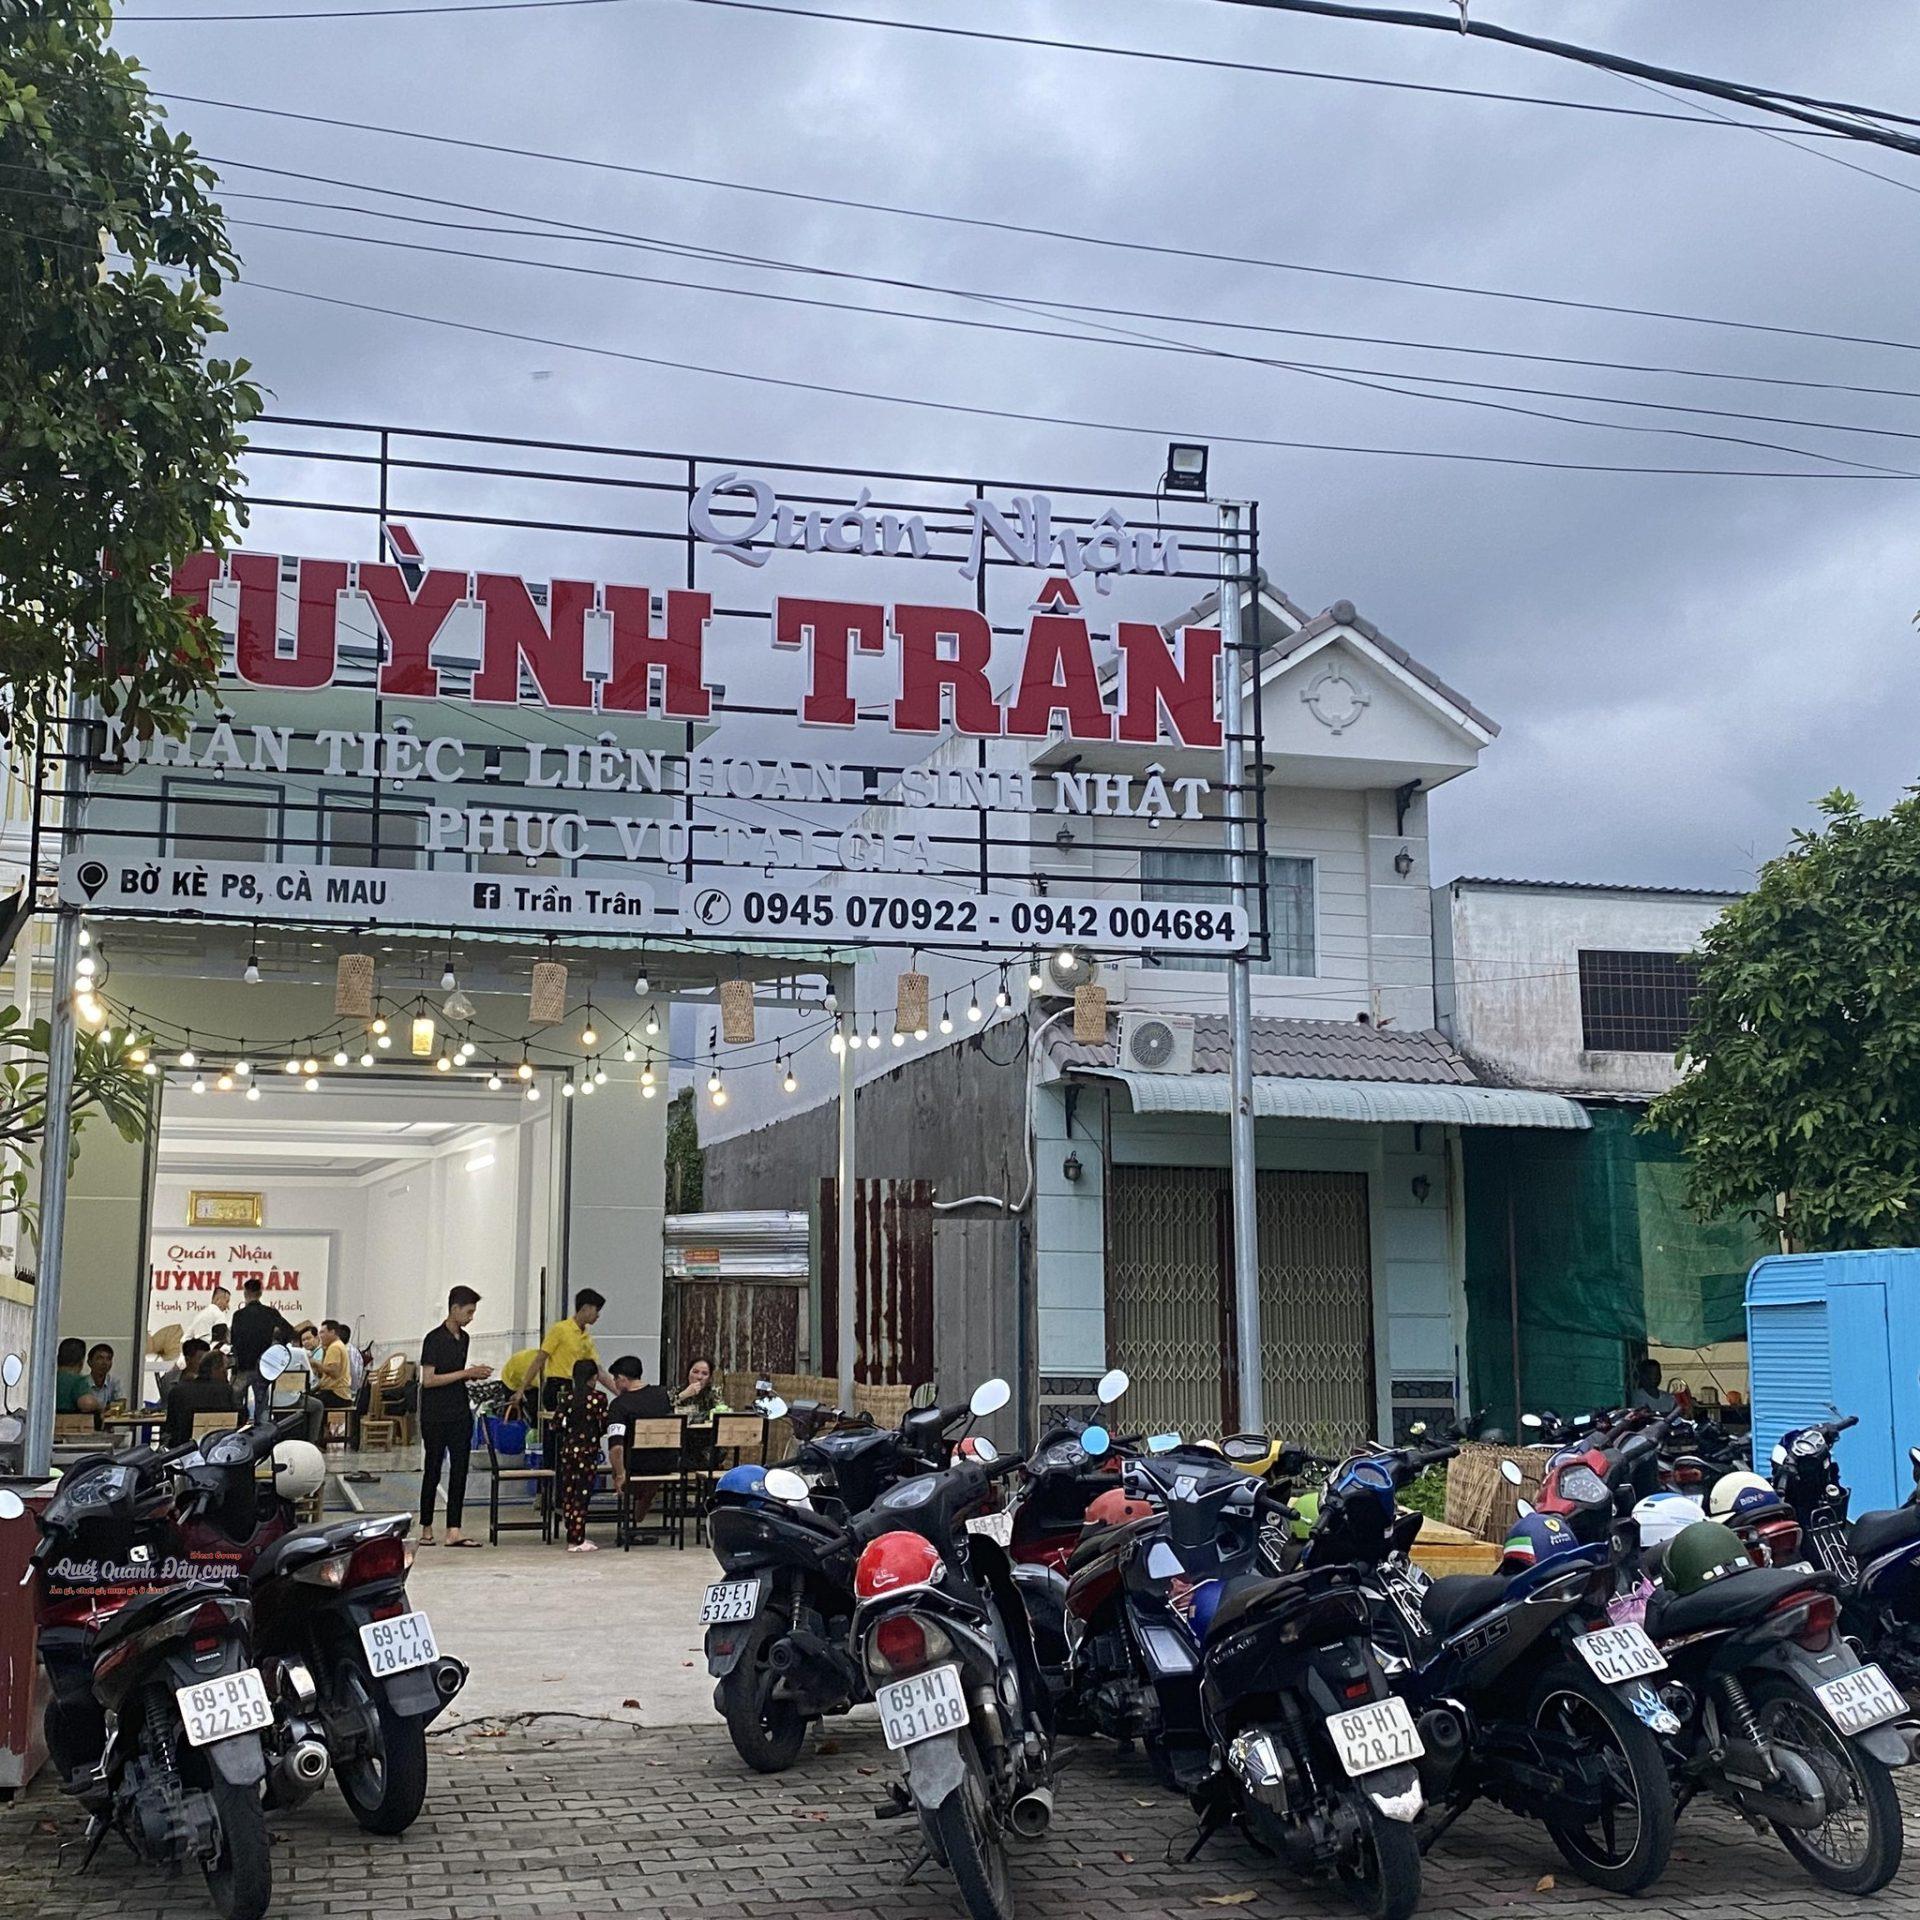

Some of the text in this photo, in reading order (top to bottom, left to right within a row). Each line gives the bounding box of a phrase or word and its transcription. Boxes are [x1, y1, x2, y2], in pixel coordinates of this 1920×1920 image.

[690, 472, 1182, 595] Quán Nhậu
[771, 577, 1227, 750] TRÂN
[315, 717, 465, 790] TIỆC
[524, 730, 666, 793] LIÊN
[685, 751, 845, 801] HOAN
[901, 764, 1037, 811] SINH
[1052, 762, 1210, 828] NHẬT
[425, 806, 588, 867] PHỤC
[610, 815, 690, 875] VỤ
[838, 826, 945, 873] GIA
[120, 863, 386, 905] BỜ KÈ P8, CÀ MAU
[514, 885, 572, 913] Trần
[585, 890, 642, 915] Trân
[743, 892, 834, 926] 0945
[846, 896, 977, 932] 070922
[1011, 902, 1098, 937] 0942
[1109, 907, 1236, 941] 004684
[167, 1244, 273, 1264] Quán Nhậu
[150, 1265, 222, 1291] UỲNH
[702, 1601, 751, 1621] 532.23
[711, 1584, 749, 1603] 69-E1
[372, 1617, 419, 1647] 69-C1
[1587, 1629, 1639, 1657] 69-B1
[372, 1639, 434, 1673] 284.48
[1595, 1648, 1660, 1680] 041.09
[192, 1677, 250, 1712] 69-B1
[890, 1673, 945, 1712] 69-N1
[1826, 1671, 1879, 1705] 69-H1
[190, 1700, 267, 1740] 322.59
[889, 1698, 962, 1741] 031.88
[1341, 1705, 1398, 1741] 69-H1
[1346, 1729, 1415, 1770] 428.27
